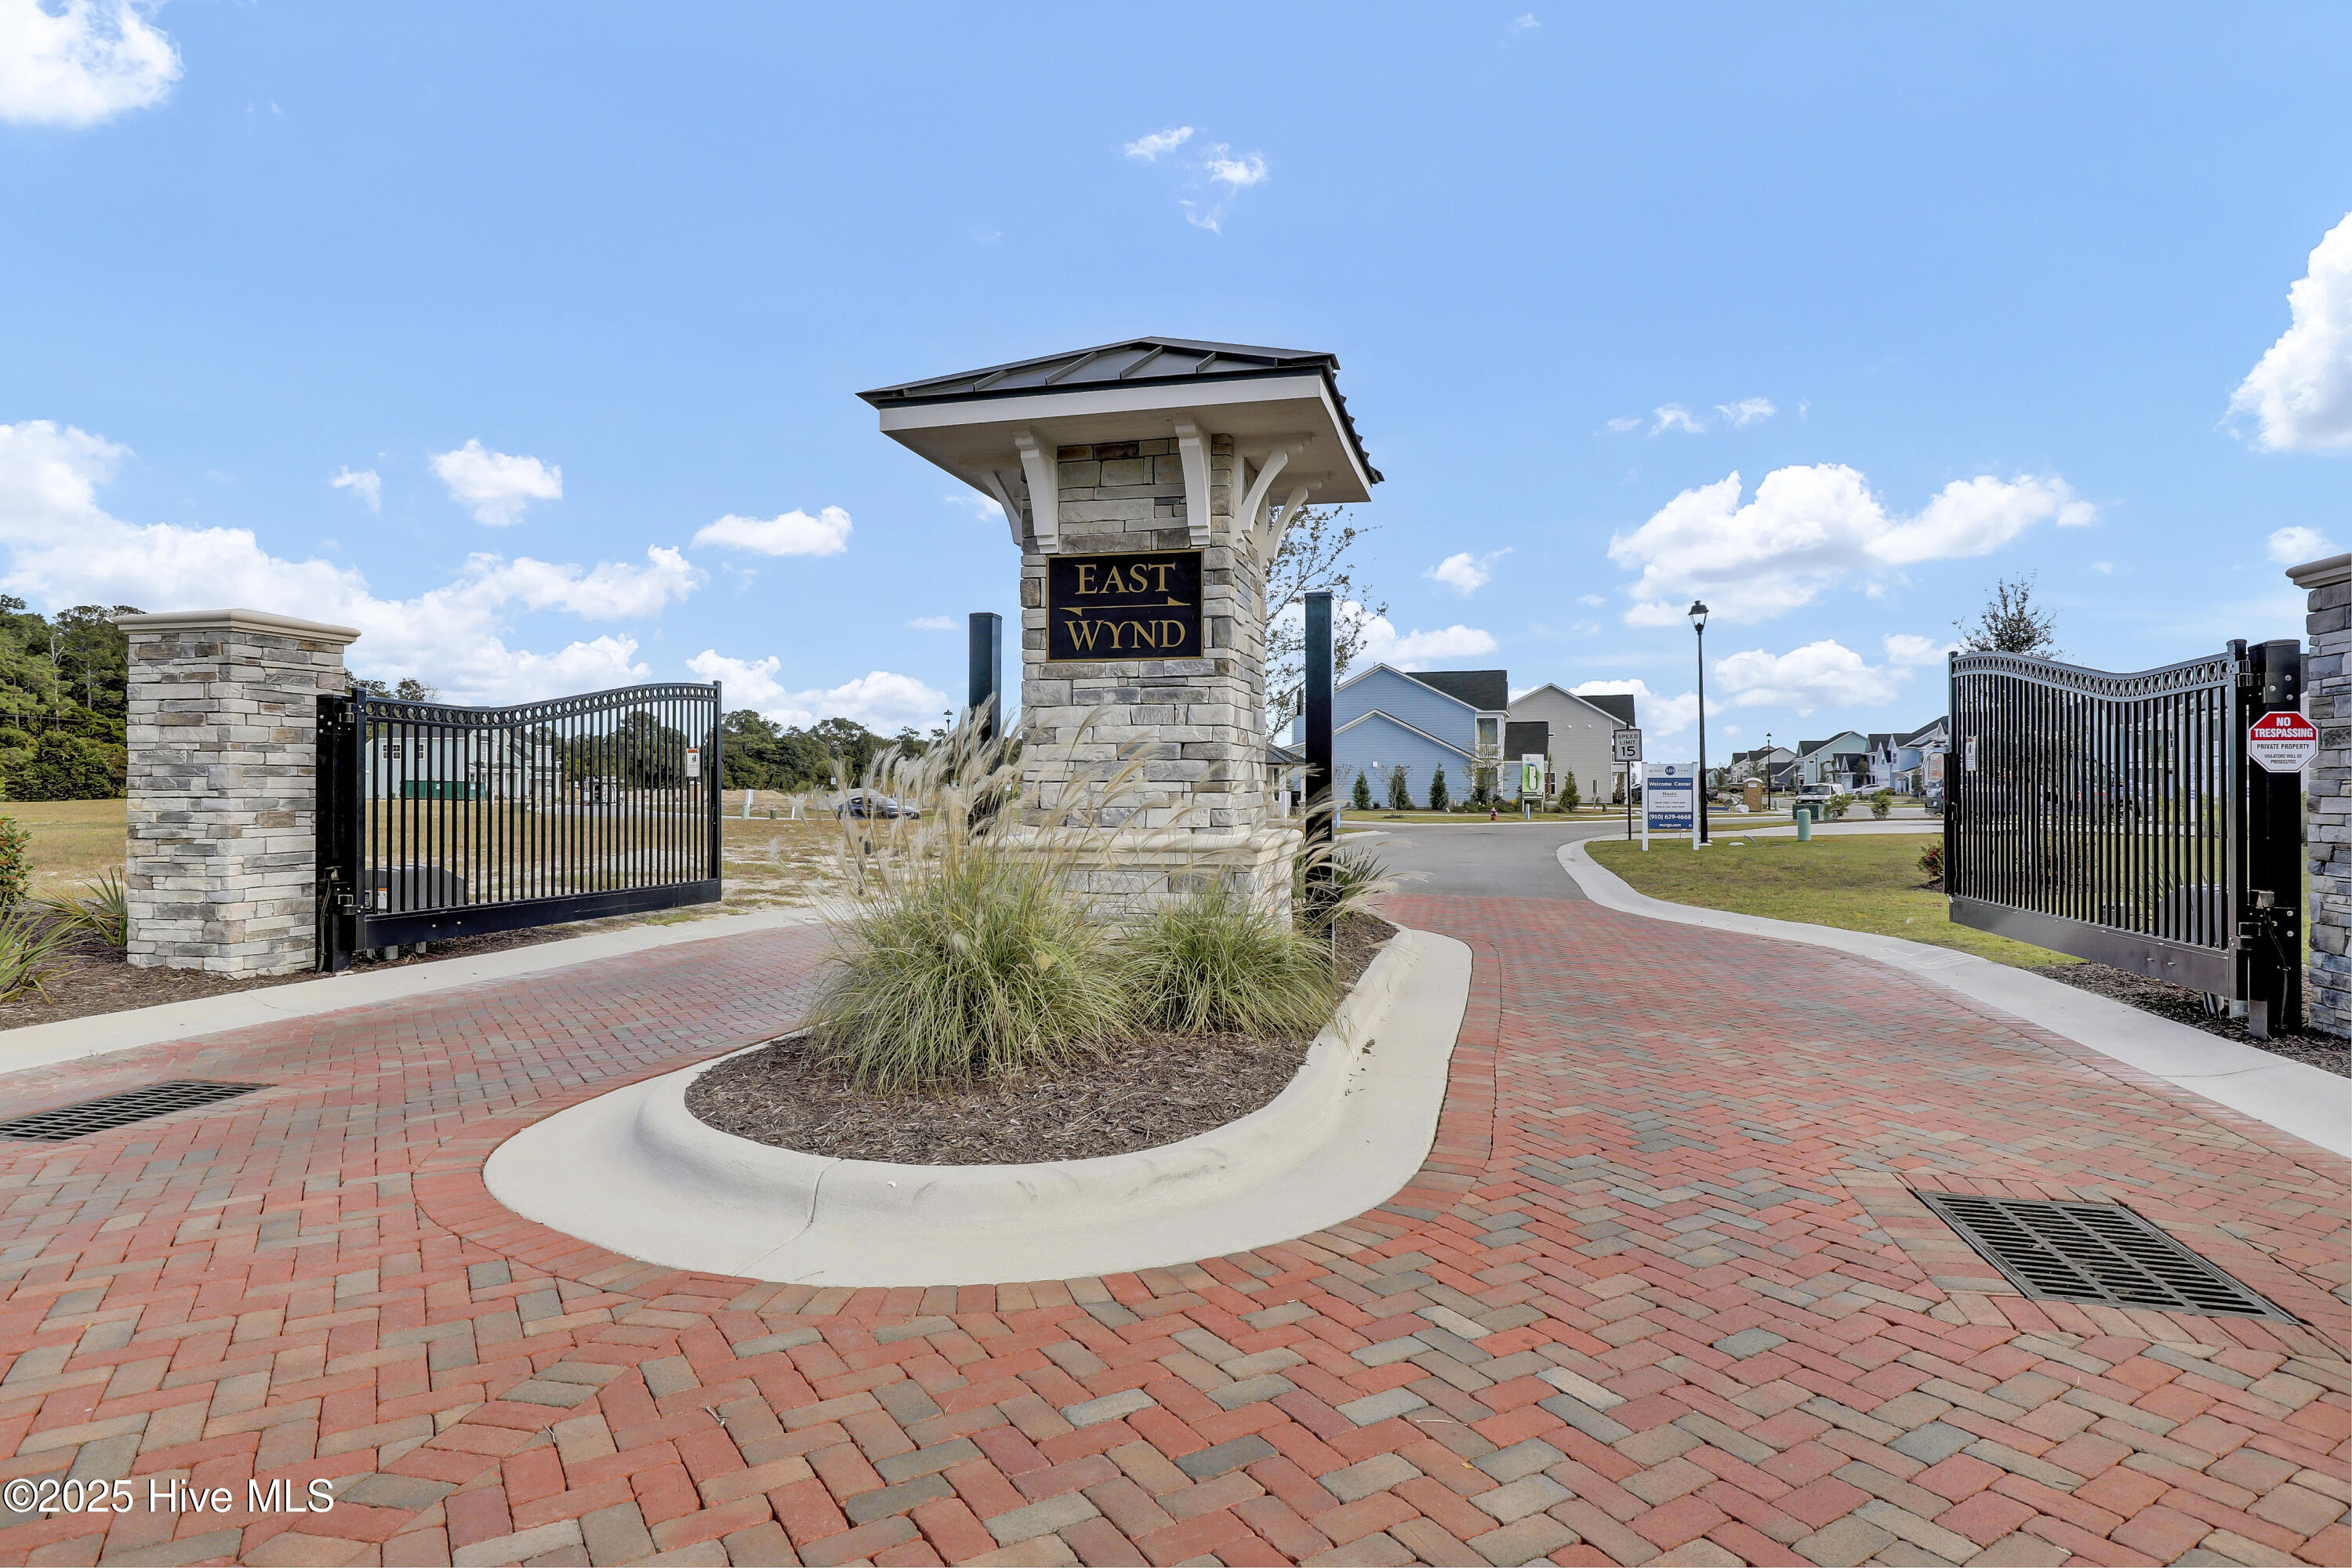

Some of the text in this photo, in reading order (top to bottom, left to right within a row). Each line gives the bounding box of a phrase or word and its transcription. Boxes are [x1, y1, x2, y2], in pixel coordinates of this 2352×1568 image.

[1075, 562, 1176, 594] EAST
[1064, 620, 1186, 651] WYND
[2276, 717, 2291, 726] NO
[2254, 728, 2313, 737] TRESPASSING
[1622, 746, 1636, 756] 15
